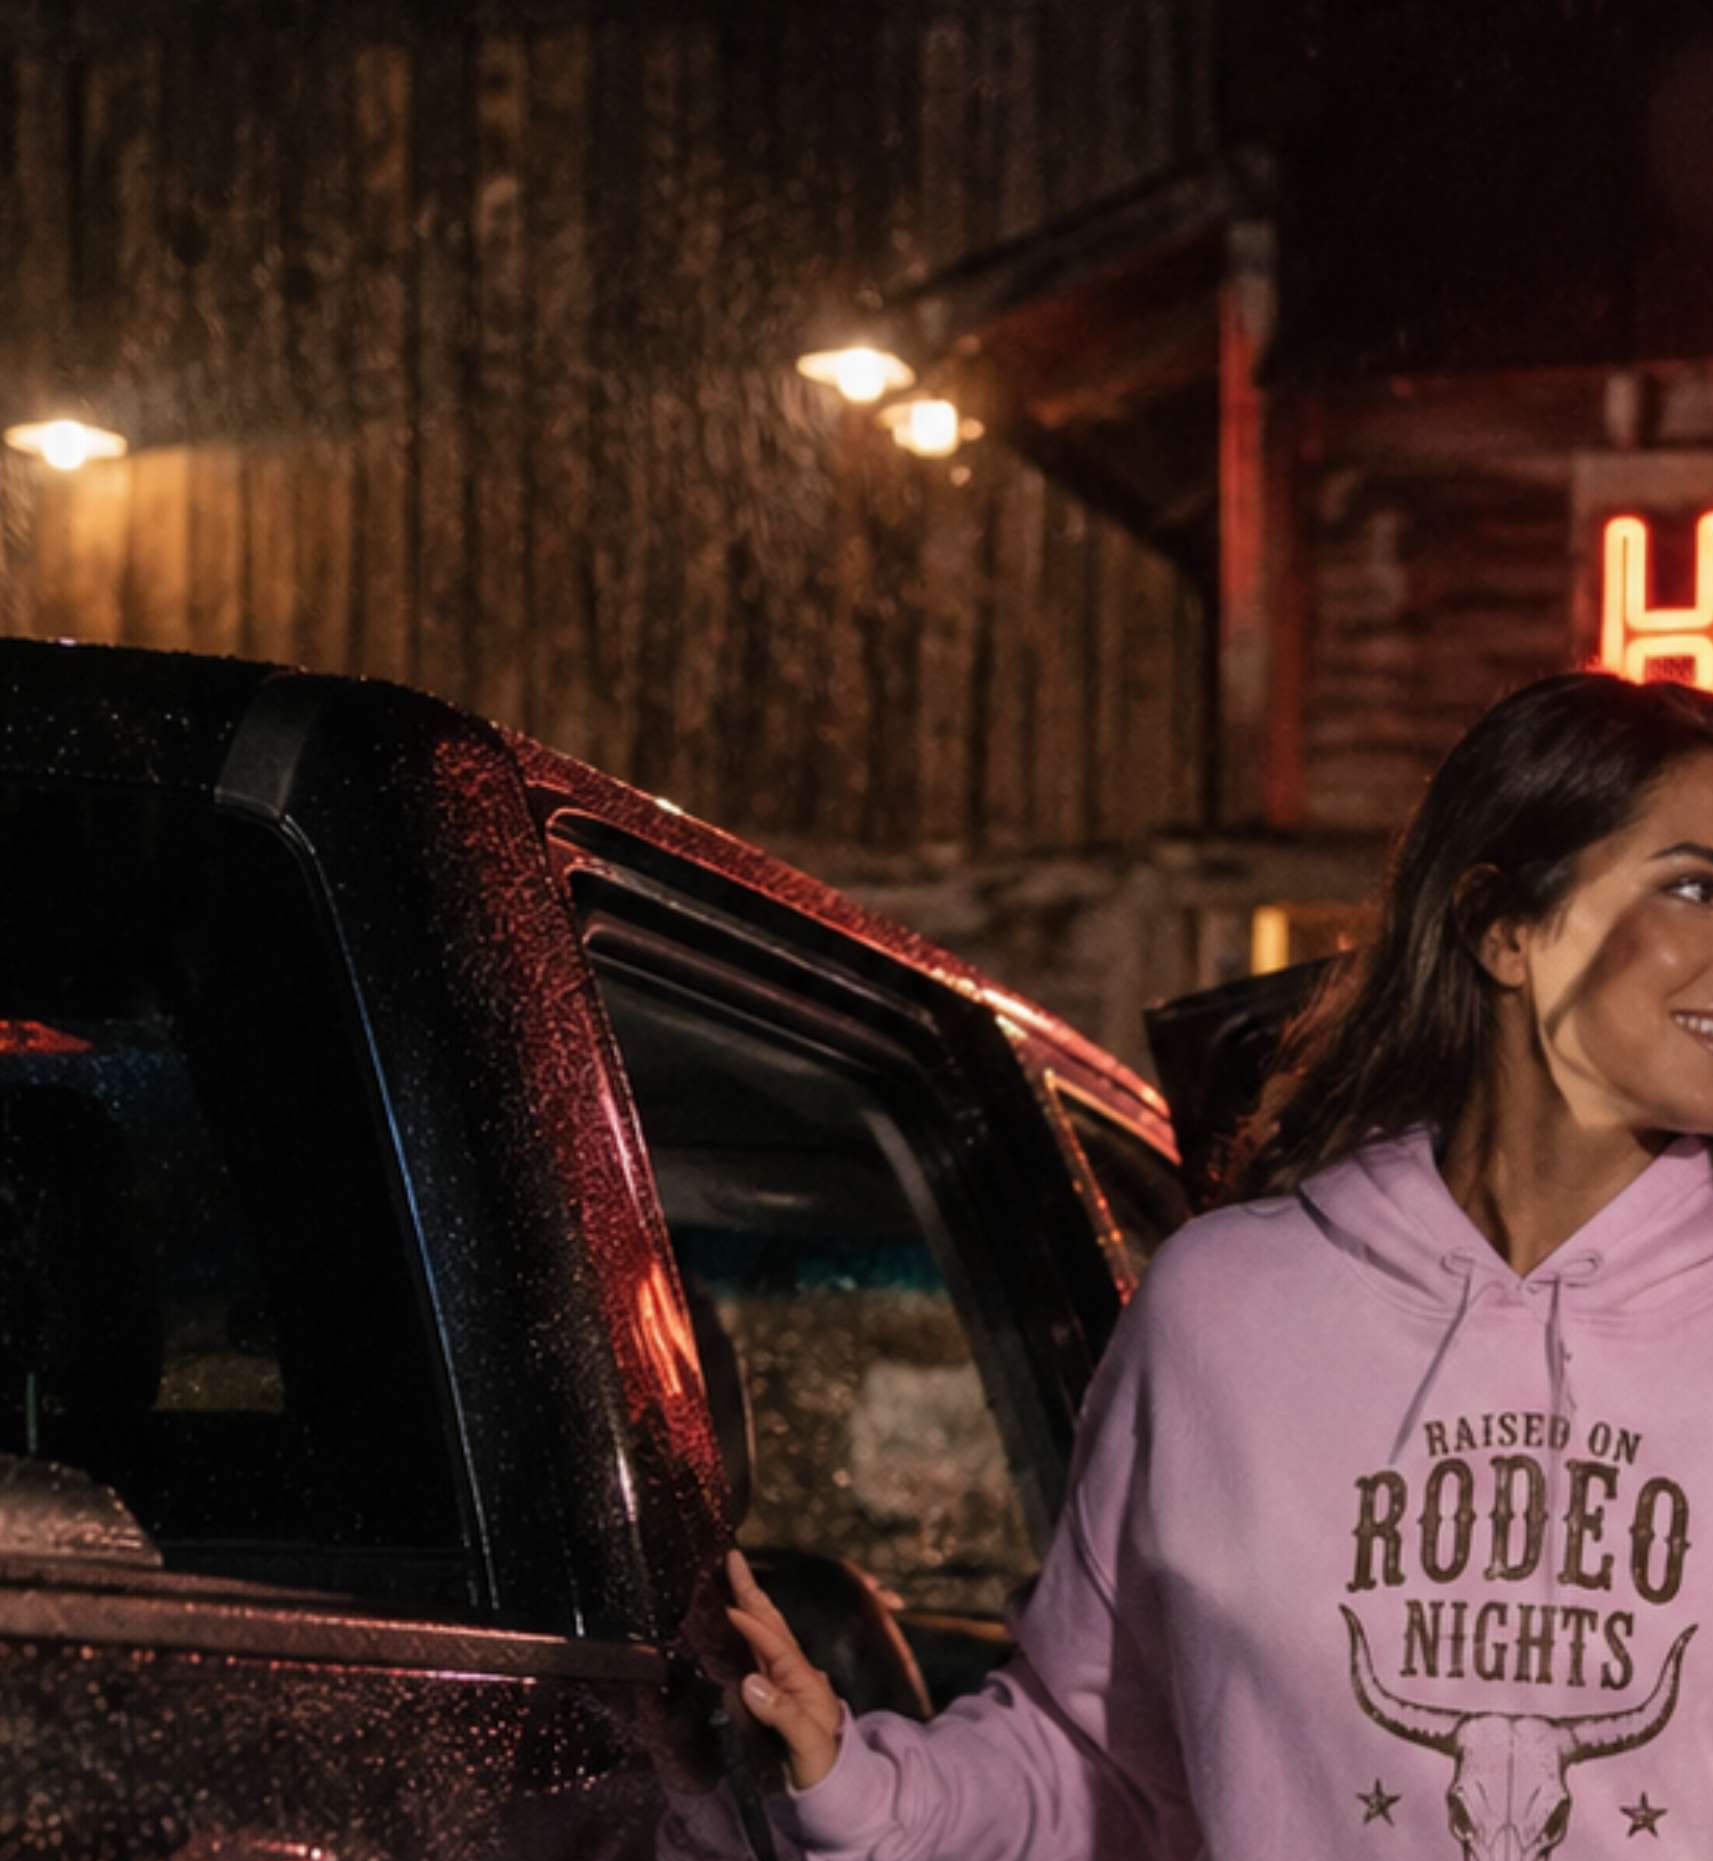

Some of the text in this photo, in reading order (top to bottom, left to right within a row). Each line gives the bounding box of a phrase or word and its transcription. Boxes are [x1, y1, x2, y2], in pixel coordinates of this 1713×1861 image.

[1423, 1411, 1642, 1465] RAISED ON
[1345, 1455, 1691, 1605] RODEO
[1399, 1600, 1635, 1691] NIGHTS
